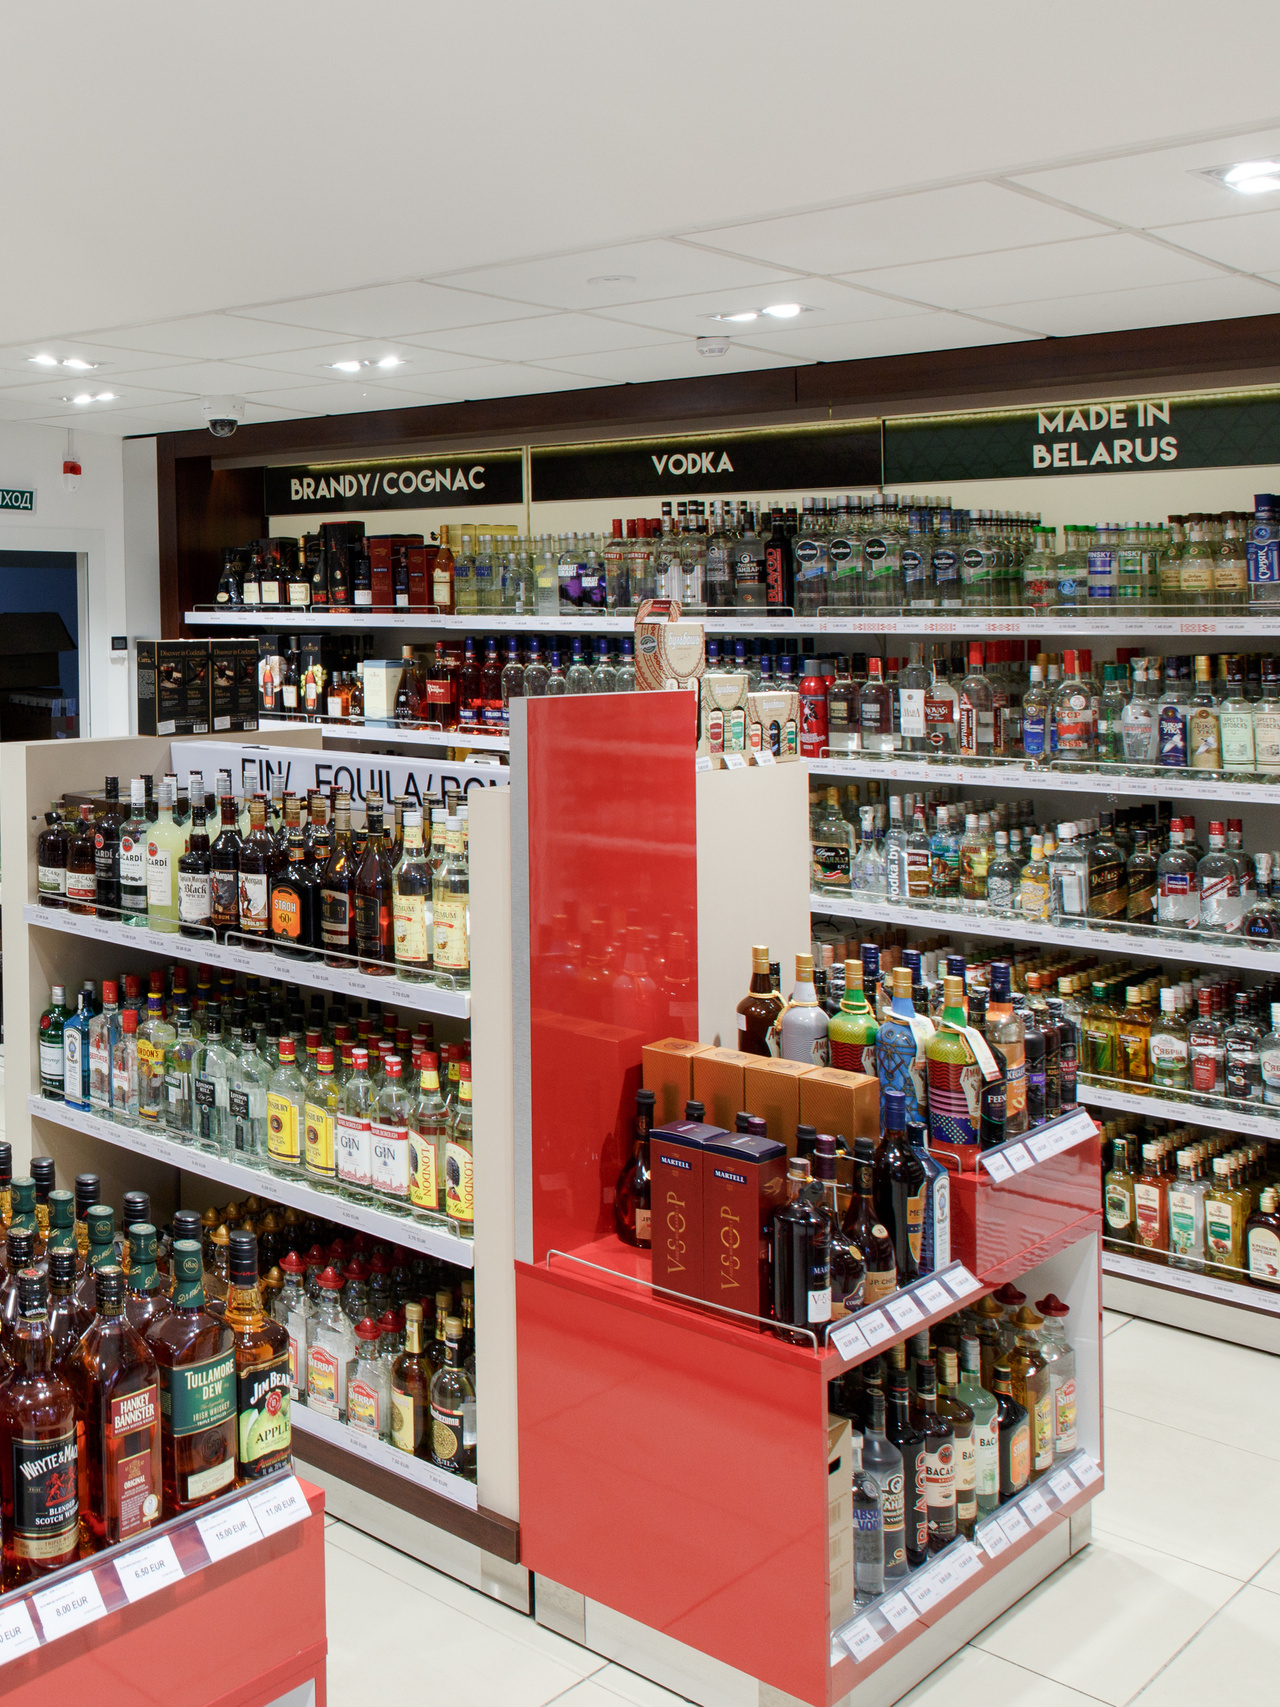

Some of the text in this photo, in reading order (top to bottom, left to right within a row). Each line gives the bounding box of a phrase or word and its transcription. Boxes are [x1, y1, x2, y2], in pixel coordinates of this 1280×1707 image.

[1037, 400, 1171, 434] MADE IN
[1032, 436, 1178, 469] BELARUS
[652, 450, 734, 477] VODKA
[290, 465, 486, 500] BRANDY/COGNAC
[185, 648, 207, 656] Cocktails
[184, 883, 206, 894] Black
[244, 876, 262, 886] Morgan
[274, 899, 296, 913] STROH
[281, 915, 290, 923] 60
[1251, 926, 1269, 935] ГРАФ
[396, 946, 410, 955] RUM
[437, 952, 450, 961] RUM
[89, 1051, 108, 1063] BEEFEATER
[195, 1080, 214, 1089] LONDON
[230, 1091, 248, 1101] LONDON
[341, 1136, 359, 1151] GIN
[375, 1145, 396, 1161] GIN
[661, 1156, 690, 1169] MARTELL
[421, 1148, 431, 1197] LONDON
[715, 1170, 746, 1183] MARTELL
[464, 1161, 474, 1209] LONDON
[308, 1358, 334, 1373] SIERRA
[185, 1358, 234, 1390] TULLAMORE
[202, 1379, 223, 1400] DEW
[250, 1371, 291, 1404] JIM BEAM
[120, 1392, 150, 1414] HANKEY
[349, 1392, 375, 1407] SIERRA
[114, 1406, 155, 1429] BANNISTER
[193, 1402, 230, 1422] IRISH WHISKEY
[256, 1423, 290, 1444] APPLE
[123, 1476, 146, 1489] ORIGINAL
[49, 1500, 76, 1516] BLENDED
[265, 1496, 297, 1517] 11,00 EUR
[35, 1513, 64, 1525] SCOTCH
[215, 1520, 248, 1541] 15,00 EUR
[134, 1559, 166, 1579] 6,50 EUR
[55, 1596, 89, 1617] 8,00 EUR
[5, 1626, 22, 1641] EUR
